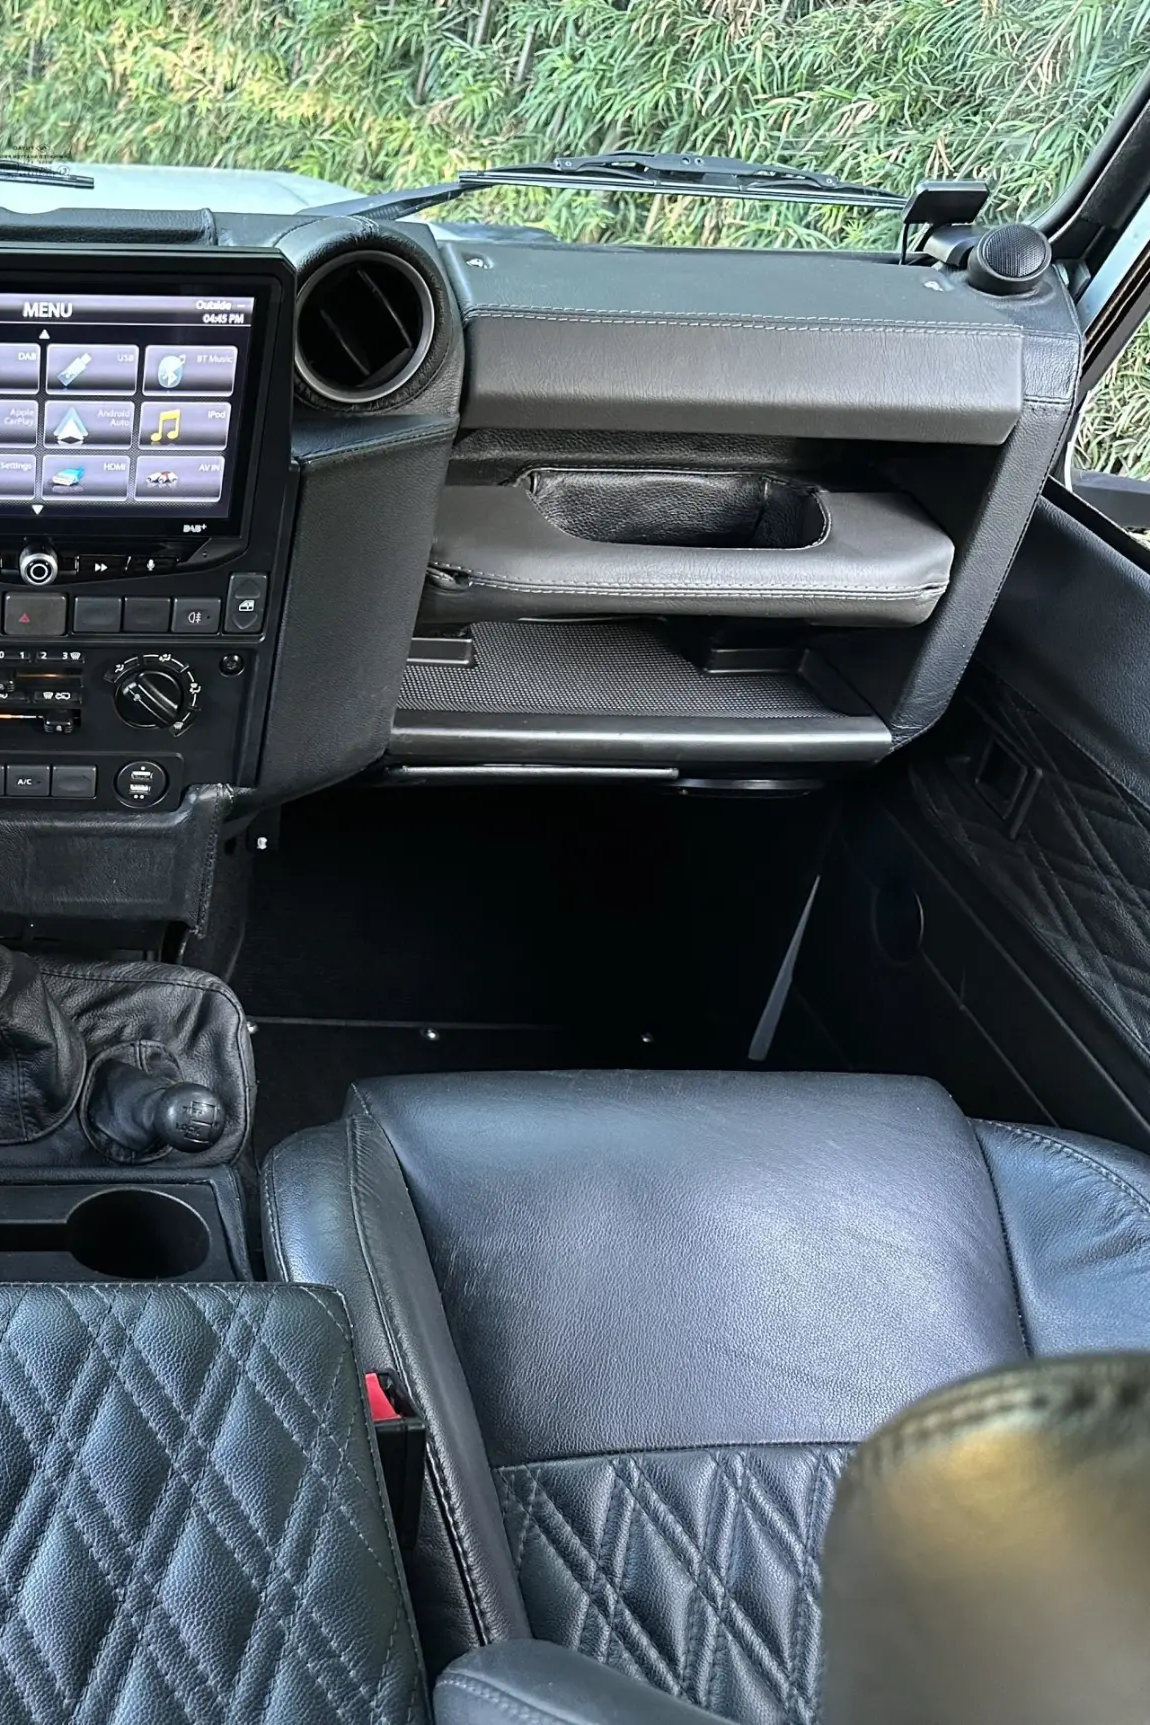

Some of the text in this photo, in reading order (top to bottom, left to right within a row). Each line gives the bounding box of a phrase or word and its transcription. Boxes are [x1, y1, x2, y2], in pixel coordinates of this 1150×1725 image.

[196, 300, 231, 310] Outside
[22, 302, 73, 318] MENU
[202, 314, 244, 324] 04:45 PM
[197, 355, 233, 363] BT Music
[10, 409, 34, 417] Apple
[98, 409, 130, 417] Android
[4, 417, 34, 426] CarPlay
[110, 419, 129, 427] Auto
[0, 462, 32, 471] Settings
[104, 463, 126, 471] HDMI
